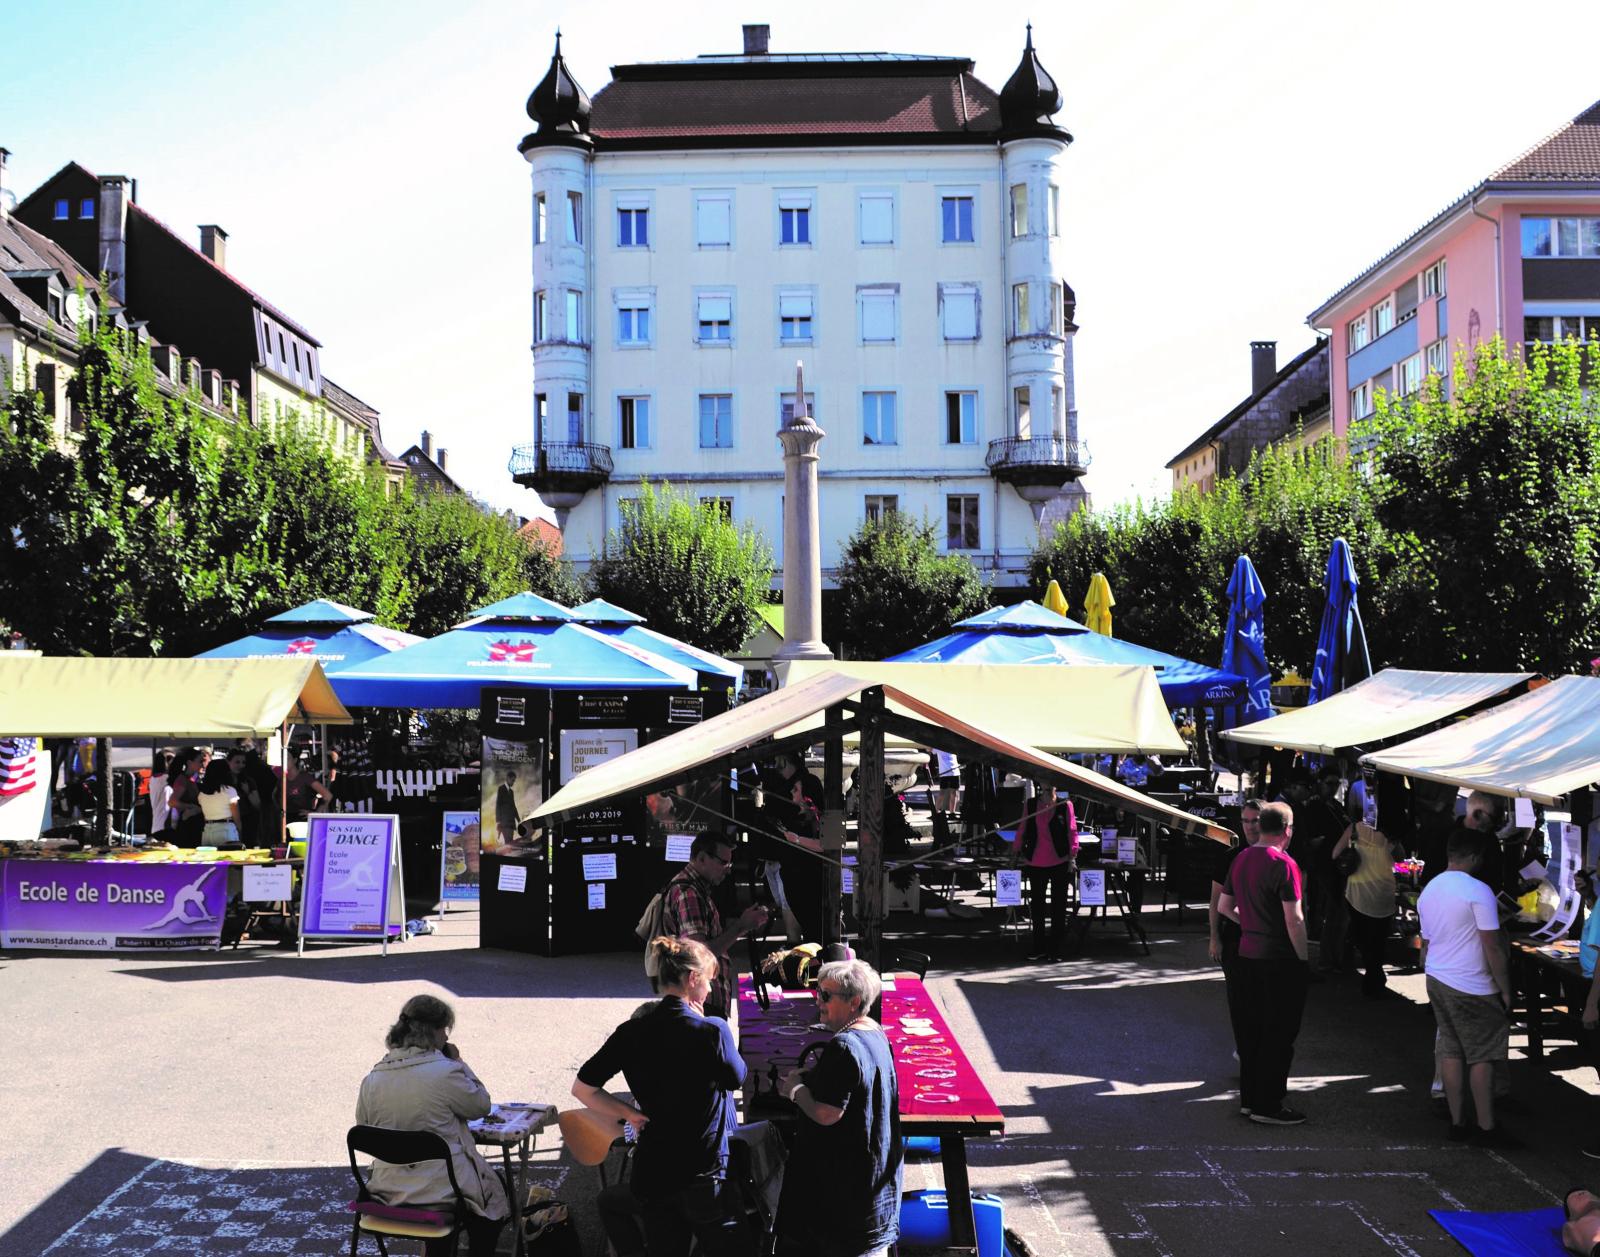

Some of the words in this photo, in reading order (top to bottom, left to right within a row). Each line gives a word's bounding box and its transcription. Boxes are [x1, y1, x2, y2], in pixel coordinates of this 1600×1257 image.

[1205, 691, 1236, 699] ARKINA
[574, 756, 585, 764] DU
[335, 834, 380, 846] DANCE
[329, 850, 349, 858] Ecole
[327, 867, 351, 875] Danse
[19, 881, 68, 901] Ecole
[75, 882, 99, 903] de
[106, 883, 166, 904] Danse
[9, 935, 108, 947] www.sunstardance.ch
